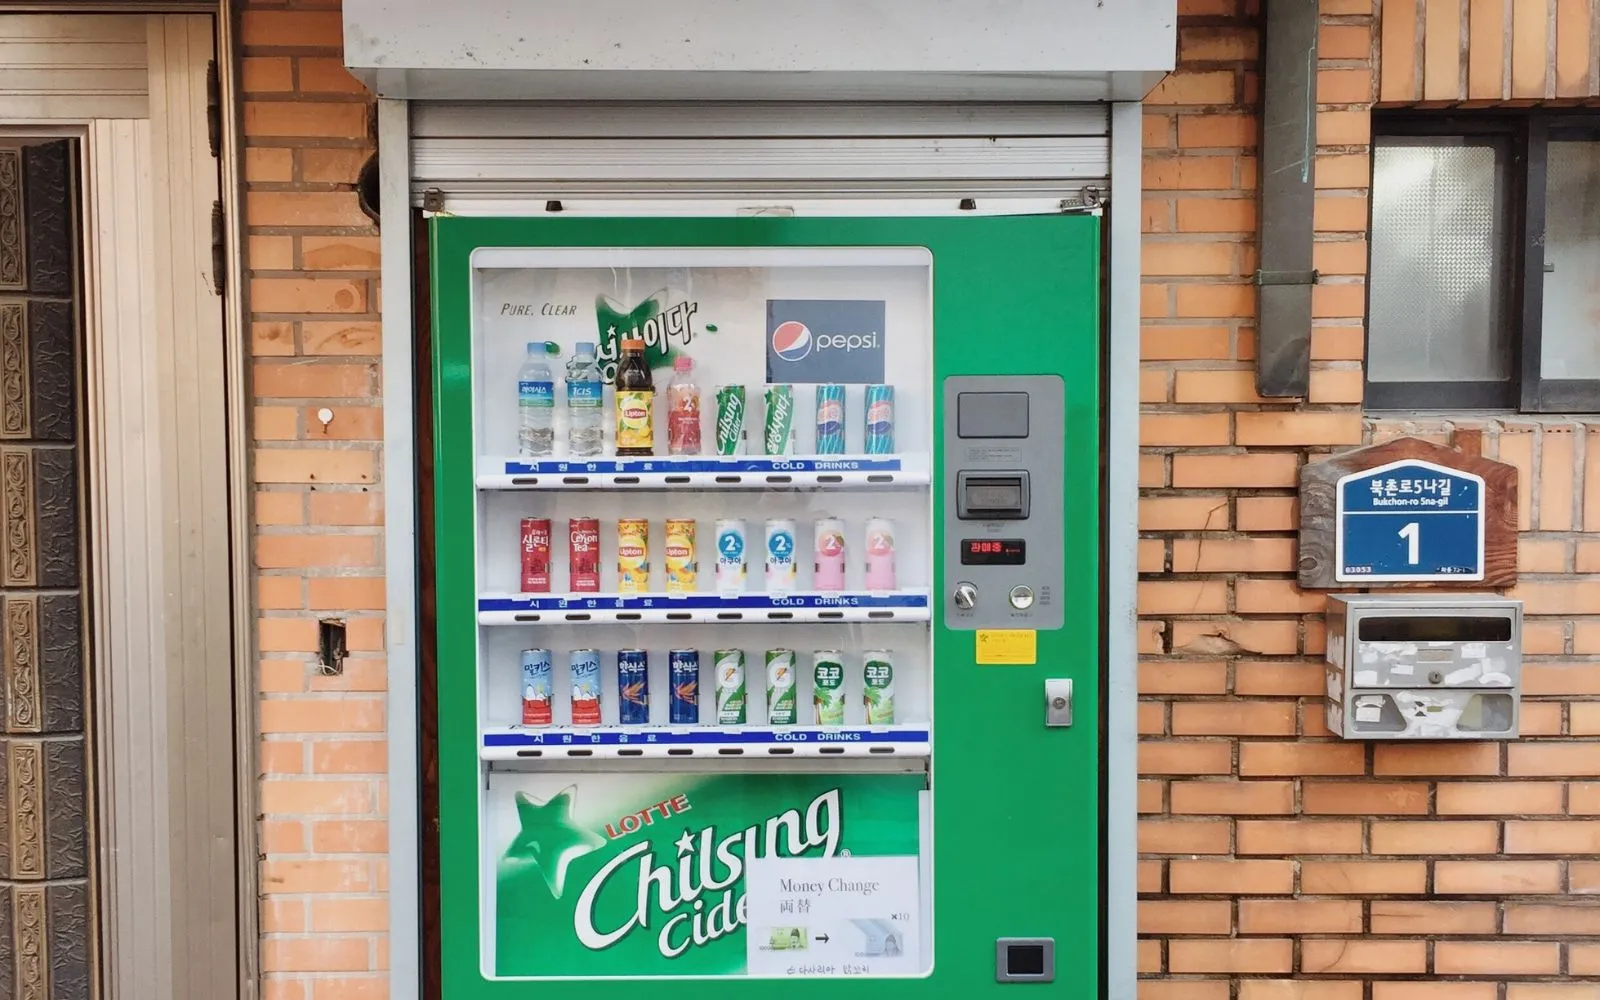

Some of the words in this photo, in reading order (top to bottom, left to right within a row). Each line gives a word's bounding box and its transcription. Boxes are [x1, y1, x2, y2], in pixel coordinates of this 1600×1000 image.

[541, 302, 577, 316] CLEAR
[816, 331, 877, 353] pepsi
[772, 461, 805, 470] COLD
[815, 461, 858, 470] DRINKS
[1370, 479, 1451, 497] 북촌로5나길
[1373, 497, 1419, 507] Bukchon-ro
[1420, 496, 1449, 508] 5na-gil
[570, 531, 598, 545] Ceylon
[1397, 522, 1419, 565] 1
[573, 543, 588, 552] Tea
[772, 597, 804, 606] COLD
[814, 597, 858, 606] DRINKS
[524, 660, 551, 676] 밀키스
[571, 660, 598, 676] 밀키스
[817, 666, 841, 679] 코코
[866, 666, 890, 679] 코코
[775, 733, 807, 742] COLD
[817, 733, 861, 742] DRINKS
[605, 794, 693, 840] LOTTE
[780, 879, 824, 896] Money
[828, 878, 879, 895] Change
